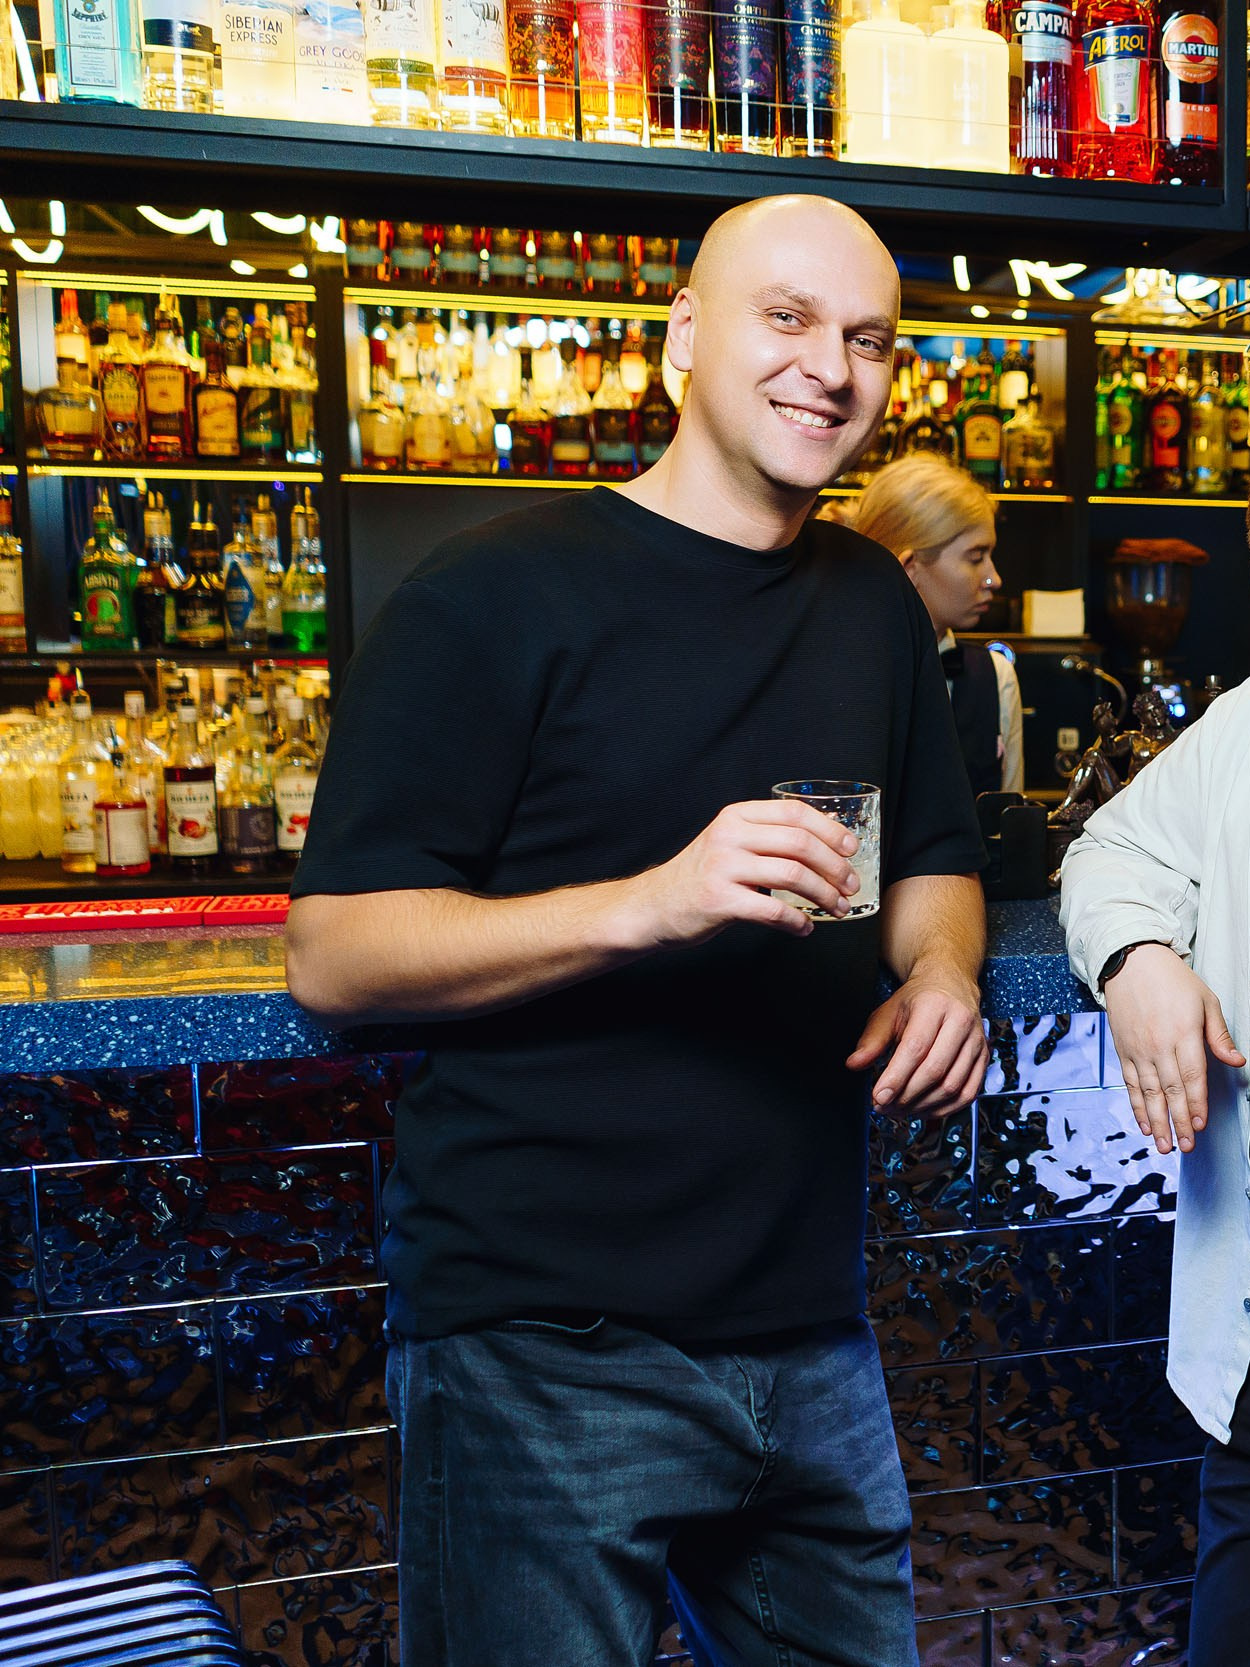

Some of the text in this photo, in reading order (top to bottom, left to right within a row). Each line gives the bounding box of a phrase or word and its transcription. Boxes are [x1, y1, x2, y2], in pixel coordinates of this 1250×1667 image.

[230, 31, 278, 46] EXPRESS
[299, 45, 327, 57] GREY
[1089, 34, 1145, 62] APEROL
[1168, 42, 1219, 58] MARTINI
